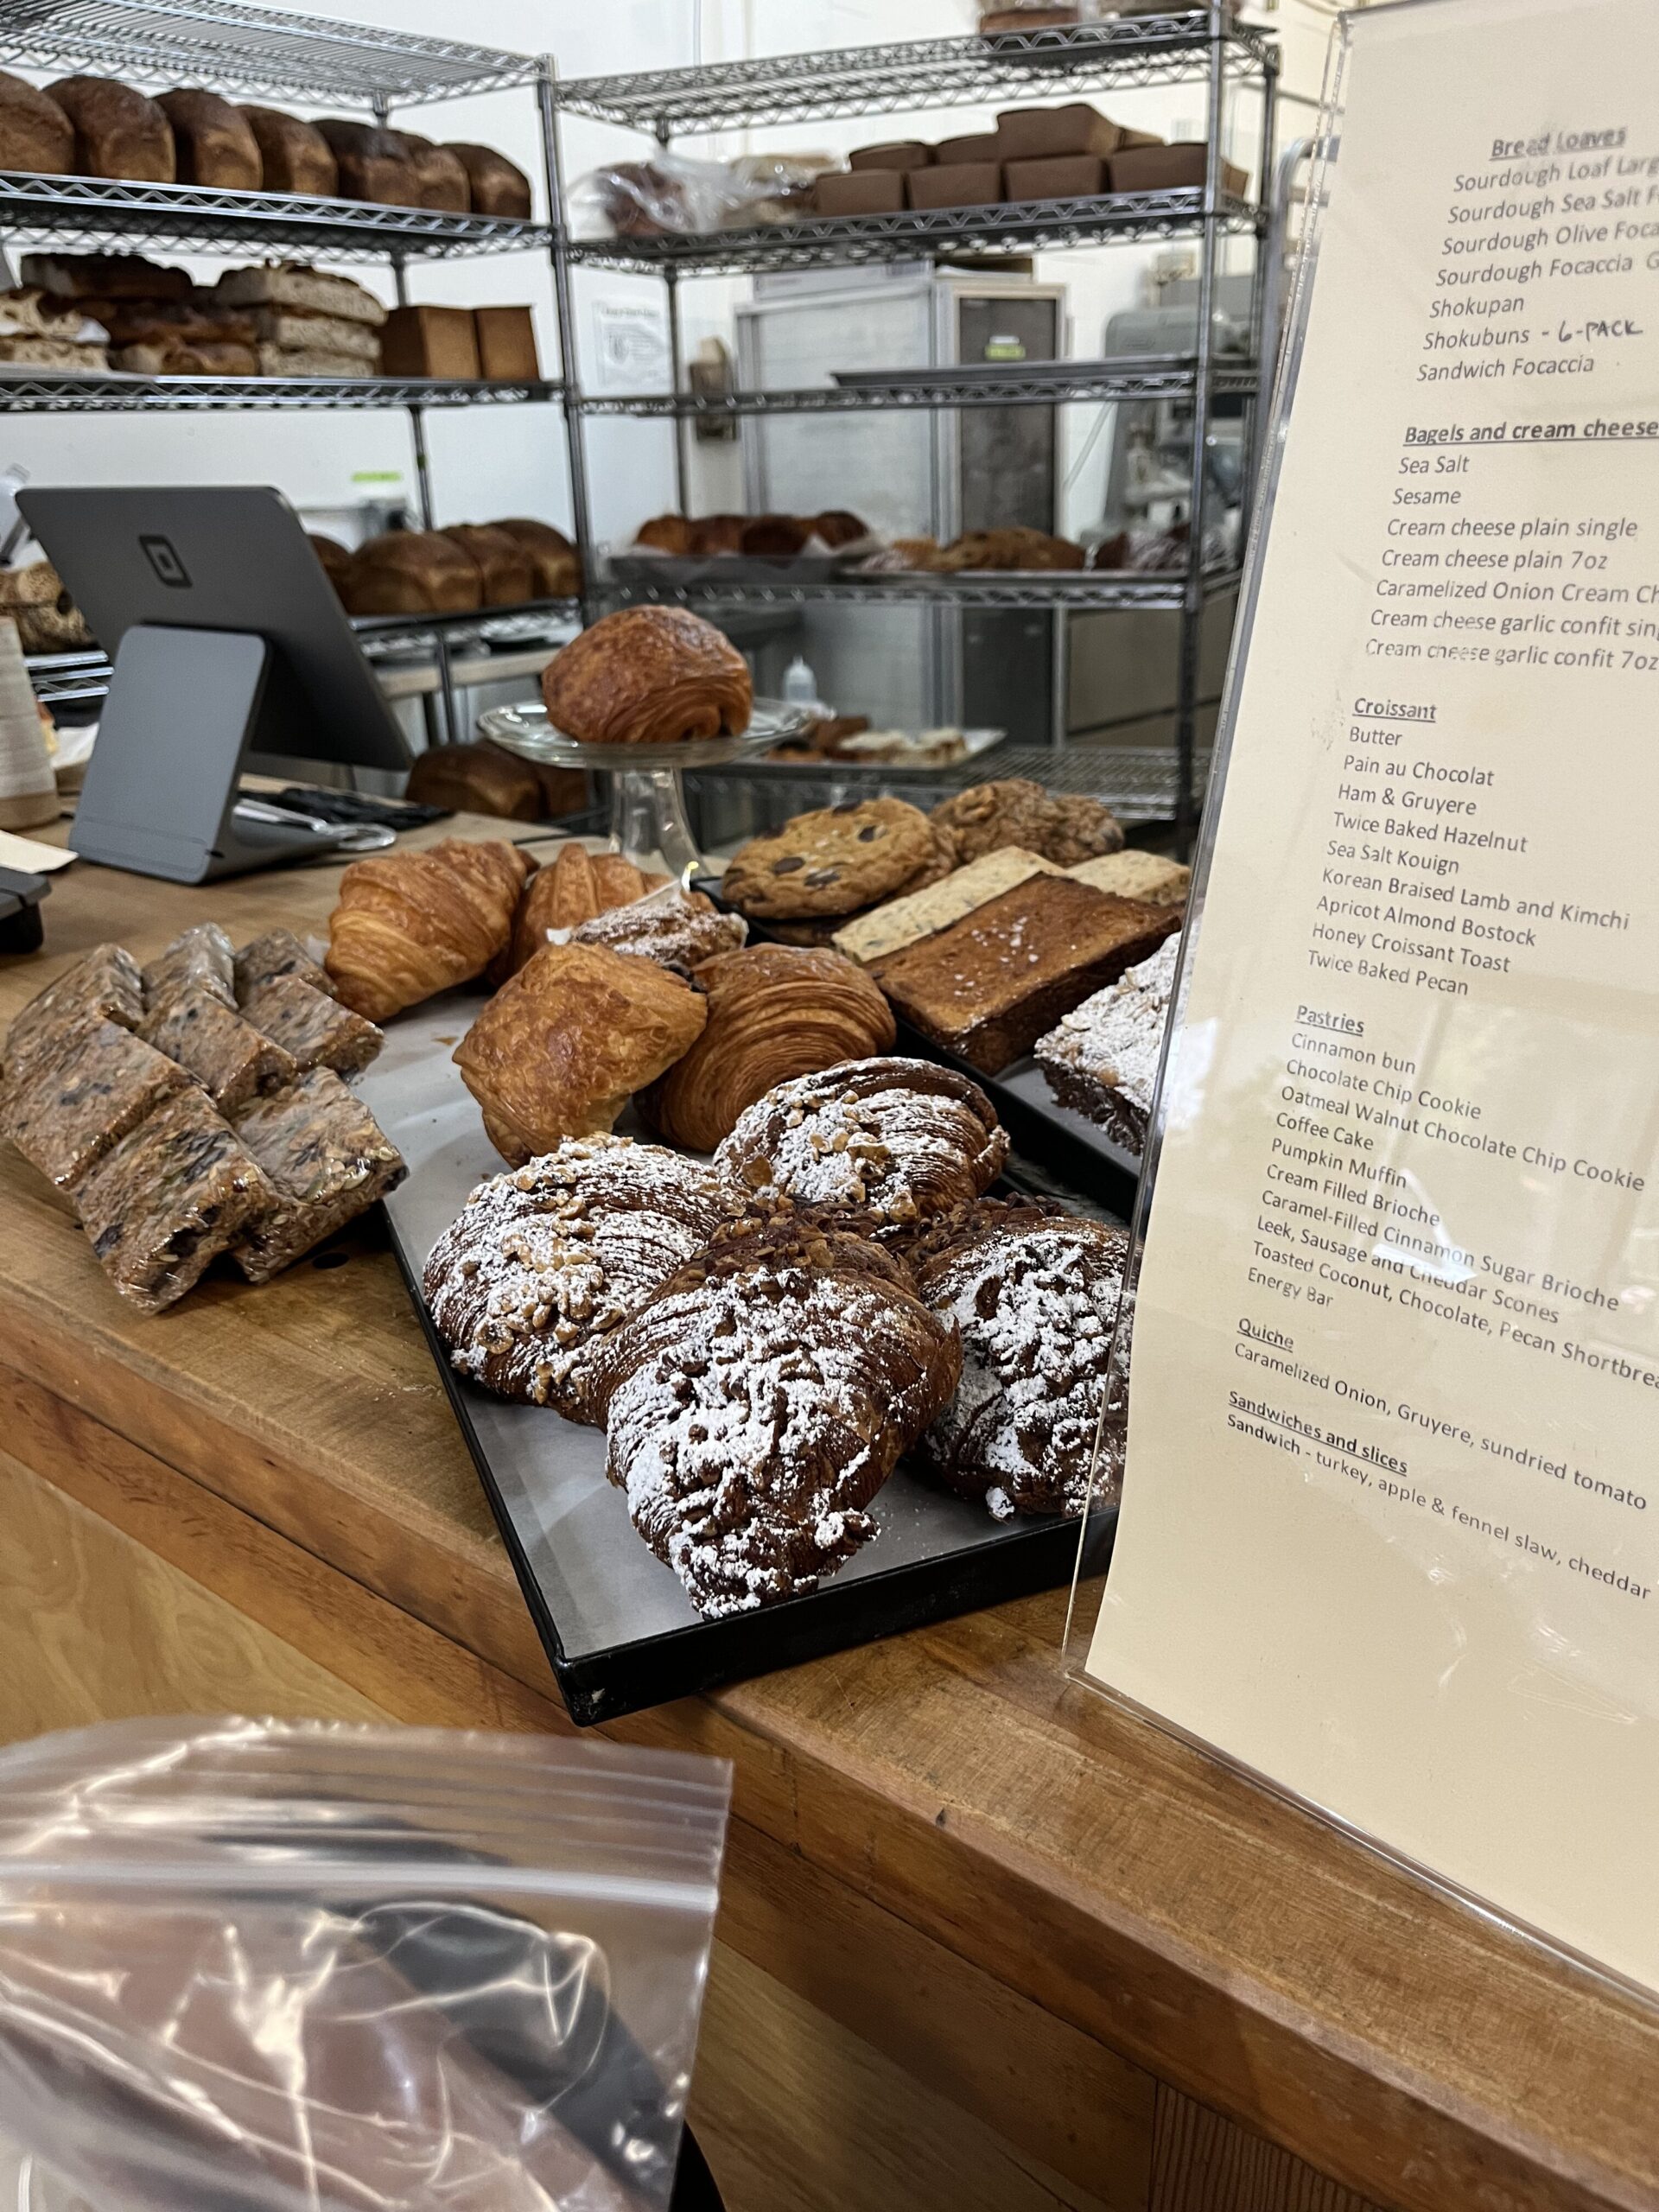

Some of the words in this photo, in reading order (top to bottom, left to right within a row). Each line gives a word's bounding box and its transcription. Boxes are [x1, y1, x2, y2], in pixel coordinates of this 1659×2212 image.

[1491, 133, 1551, 157] Bread
[1555, 127, 1627, 154] Loaves
[1453, 163, 1560, 192] Sourdough
[1568, 156, 1612, 181] Loaf
[1447, 196, 1554, 224] Sourdough
[1561, 194, 1596, 213] Sea
[1601, 188, 1641, 209] Salt
[1646, 184, 1659, 205] F
[1441, 228, 1548, 255] Sourdough
[1555, 224, 1608, 245] Olive
[1435, 261, 1542, 286] Sourdough
[1548, 254, 1633, 276] Focaccia
[1429, 296, 1524, 318] Shokupan
[1422, 327, 1529, 350] Shokubuns
[1558, 320, 1643, 342] 6-PACK
[1416, 359, 1505, 382] Sandwich
[1512, 354, 1594, 376] Focaccia
[1404, 424, 1464, 445] Bagels
[1470, 422, 1507, 441] and
[1512, 424, 1575, 440] cream
[1584, 419, 1659, 437] cheese
[1398, 457, 1429, 474] Sea
[1434, 455, 1470, 474] Salt
[1392, 488, 1461, 505] Sesame
[1388, 518, 1446, 536] Cream
[1451, 518, 1515, 536] cheese
[1520, 518, 1569, 540] plain
[1576, 518, 1637, 541] single
[1382, 550, 1439, 568] Cream
[1445, 549, 1509, 568] cheese
[1514, 550, 1562, 571] plain
[1571, 551, 1607, 569] 7oz
[1376, 580, 1487, 598] Caramelized
[1493, 582, 1554, 601] Onion
[1561, 583, 1629, 602] Cream
[1370, 609, 1427, 627] Cream
[1433, 611, 1496, 630] cheese
[1500, 613, 1554, 634] garlic
[1560, 615, 1621, 636] confit
[1626, 619, 1659, 640] sin
[1365, 639, 1421, 657] Cream
[1427, 644, 1490, 661] cheese
[1495, 645, 1548, 665] garlic
[1554, 648, 1614, 668] confit
[1621, 651, 1657, 671] 7oz
[1353, 698, 1436, 722] Croissant
[1350, 727, 1403, 746] Butter
[1344, 755, 1380, 773] Pain
[1385, 761, 1406, 776] au
[1413, 761, 1495, 786] Chocolat
[1338, 785, 1376, 803] Ham
[1382, 788, 1395, 805] &
[1402, 791, 1477, 816] Gruyere
[1334, 811, 1380, 832] Twice
[1384, 819, 1438, 840] Baked
[1444, 826, 1528, 852] Hazelnut
[1326, 841, 1356, 858] Sea
[1360, 844, 1392, 863] Salt
[1397, 850, 1459, 875] Kouign
[1322, 868, 1382, 891] Korean
[1389, 878, 1455, 903] Braised
[1460, 889, 1510, 912] Lamb
[1516, 899, 1554, 918] and
[1560, 904, 1630, 930] Kimchi
[1317, 895, 1380, 920] Apricot
[1383, 906, 1456, 932] Almond
[1462, 919, 1536, 947] Bostock
[1313, 923, 1365, 948] Honey
[1371, 933, 1455, 962] Croissant
[1460, 948, 1511, 973] Toast
[1308, 950, 1353, 973] Twice
[1358, 960, 1410, 984] Baked
[1416, 970, 1469, 995] Pecan
[1295, 1005, 1364, 1036] Pastries
[1292, 1033, 1376, 1065] Cinnamon
[1382, 1052, 1416, 1074] bun
[1287, 1059, 1369, 1091] Chocolate
[1373, 1080, 1412, 1103] Chip
[1418, 1090, 1482, 1119] Cookie
[1276, 1112, 1329, 1138] Coffee
[1333, 1128, 1374, 1150] Cake
[1281, 1086, 1350, 1116] Oatmeal
[1355, 1103, 1420, 1134] Walnut
[1424, 1122, 1516, 1159] Chocolate
[1522, 1147, 1567, 1173] Chip
[1573, 1160, 1645, 1192] Cookie
[1272, 1138, 1343, 1170] Pumpkin
[1349, 1159, 1407, 1188] Muffin
[1267, 1164, 1318, 1191] Cream
[1323, 1180, 1368, 1205] Filled
[1373, 1194, 1440, 1226] Brioche
[1262, 1190, 1378, 1237] Caramel-Filled
[1384, 1227, 1475, 1266] Cinnamon
[1480, 1255, 1535, 1285] Sugar
[1541, 1274, 1620, 1312] Brioche
[1248, 1267, 1302, 1299] Energy
[1306, 1287, 1333, 1306] Bar
[1257, 1215, 1295, 1242] Leek,
[1300, 1229, 1367, 1262] Sausage
[1371, 1253, 1404, 1274] and
[1492, 1289, 1560, 1324] Scones
[1254, 1241, 1313, 1272] Toasted
[1319, 1262, 1393, 1302] Coconut,
[1399, 1288, 1493, 1336] Chocolate,
[1499, 1321, 1555, 1353] Pecan
[1237, 1318, 1294, 1353] Quiche
[1229, 1391, 1321, 1439] Sandwiches
[1326, 1433, 1357, 1453] and
[1361, 1446, 1408, 1477] slices
[1235, 1343, 1330, 1389] Caramelized
[1334, 1381, 1391, 1415] Onion,
[1397, 1403, 1475, 1447] Gruyere,
[1480, 1437, 1567, 1480] sundried
[1573, 1470, 1647, 1510] tomato
[1228, 1414, 1300, 1455] Sandwich
[1316, 1452, 1372, 1487] turkey,
[1378, 1479, 1426, 1507] apple
[1431, 1497, 1445, 1516] &
[1452, 1505, 1509, 1541] fennel
[1515, 1535, 1561, 1566] slaw,
[1568, 1556, 1651, 1599] cheddar
